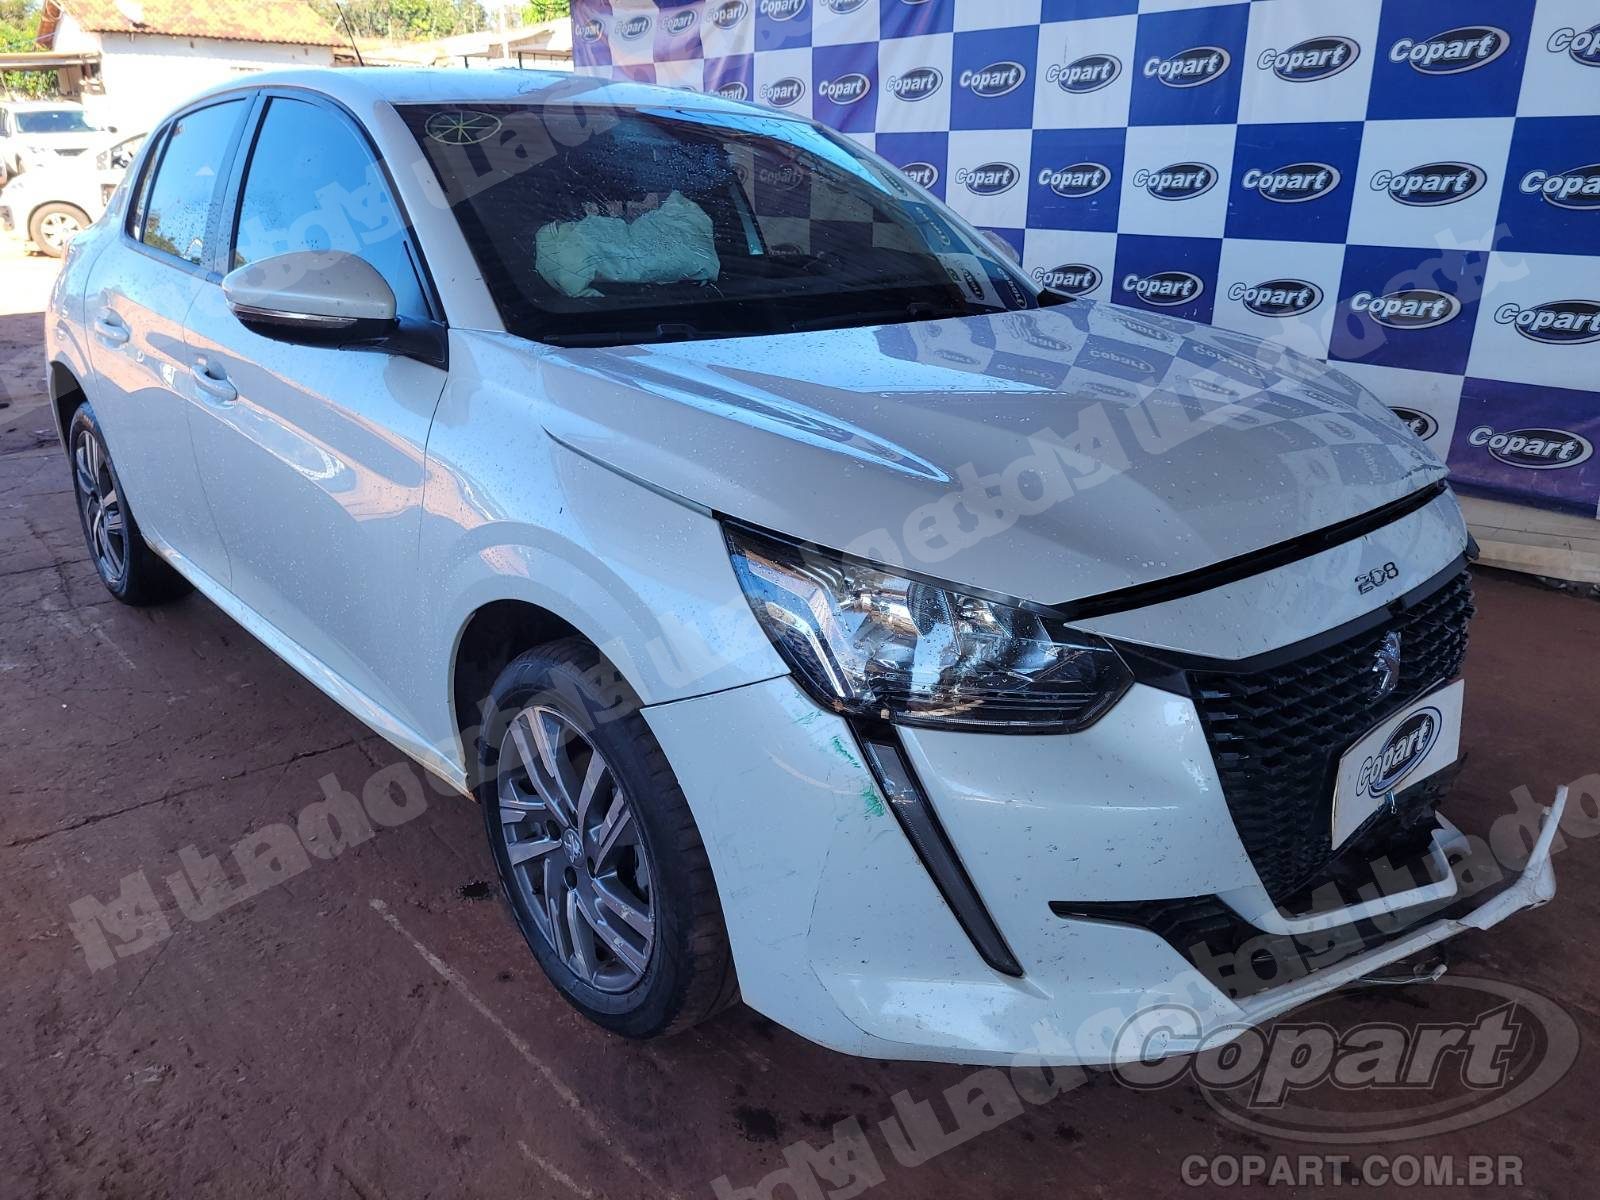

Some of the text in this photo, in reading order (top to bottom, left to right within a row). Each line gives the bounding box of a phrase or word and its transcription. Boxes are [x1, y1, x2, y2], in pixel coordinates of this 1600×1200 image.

[706, 2, 743, 22] Copart
[760, 0, 800, 15] Copart
[662, 13, 693, 31] Copart
[1256, 46, 1348, 73] Copart
[1388, 33, 1496, 65] Copart
[1045, 62, 1112, 85] Copart
[1143, 52, 1221, 78] Copart
[818, 77, 863, 99] Copart
[886, 74, 935, 95] Copart
[959, 66, 1018, 89] Copart
[760, 82, 798, 100] Copart
[955, 167, 1011, 188] Copart
[1038, 168, 1103, 190] Copart
[1132, 167, 1206, 191] Copart
[1241, 168, 1328, 192] Copart
[1370, 169, 1472, 196] Copart
[1519, 170, 1600, 200] Copa
[1031, 266, 1093, 288] Copart
[1122, 273, 1193, 297] Copart
[1228, 281, 1312, 307] Copart
[1350, 291, 1448, 319] Copart
[1468, 425, 1577, 460] Copart
[1354, 561, 1399, 596] 208
[1356, 714, 1433, 797] Copart
